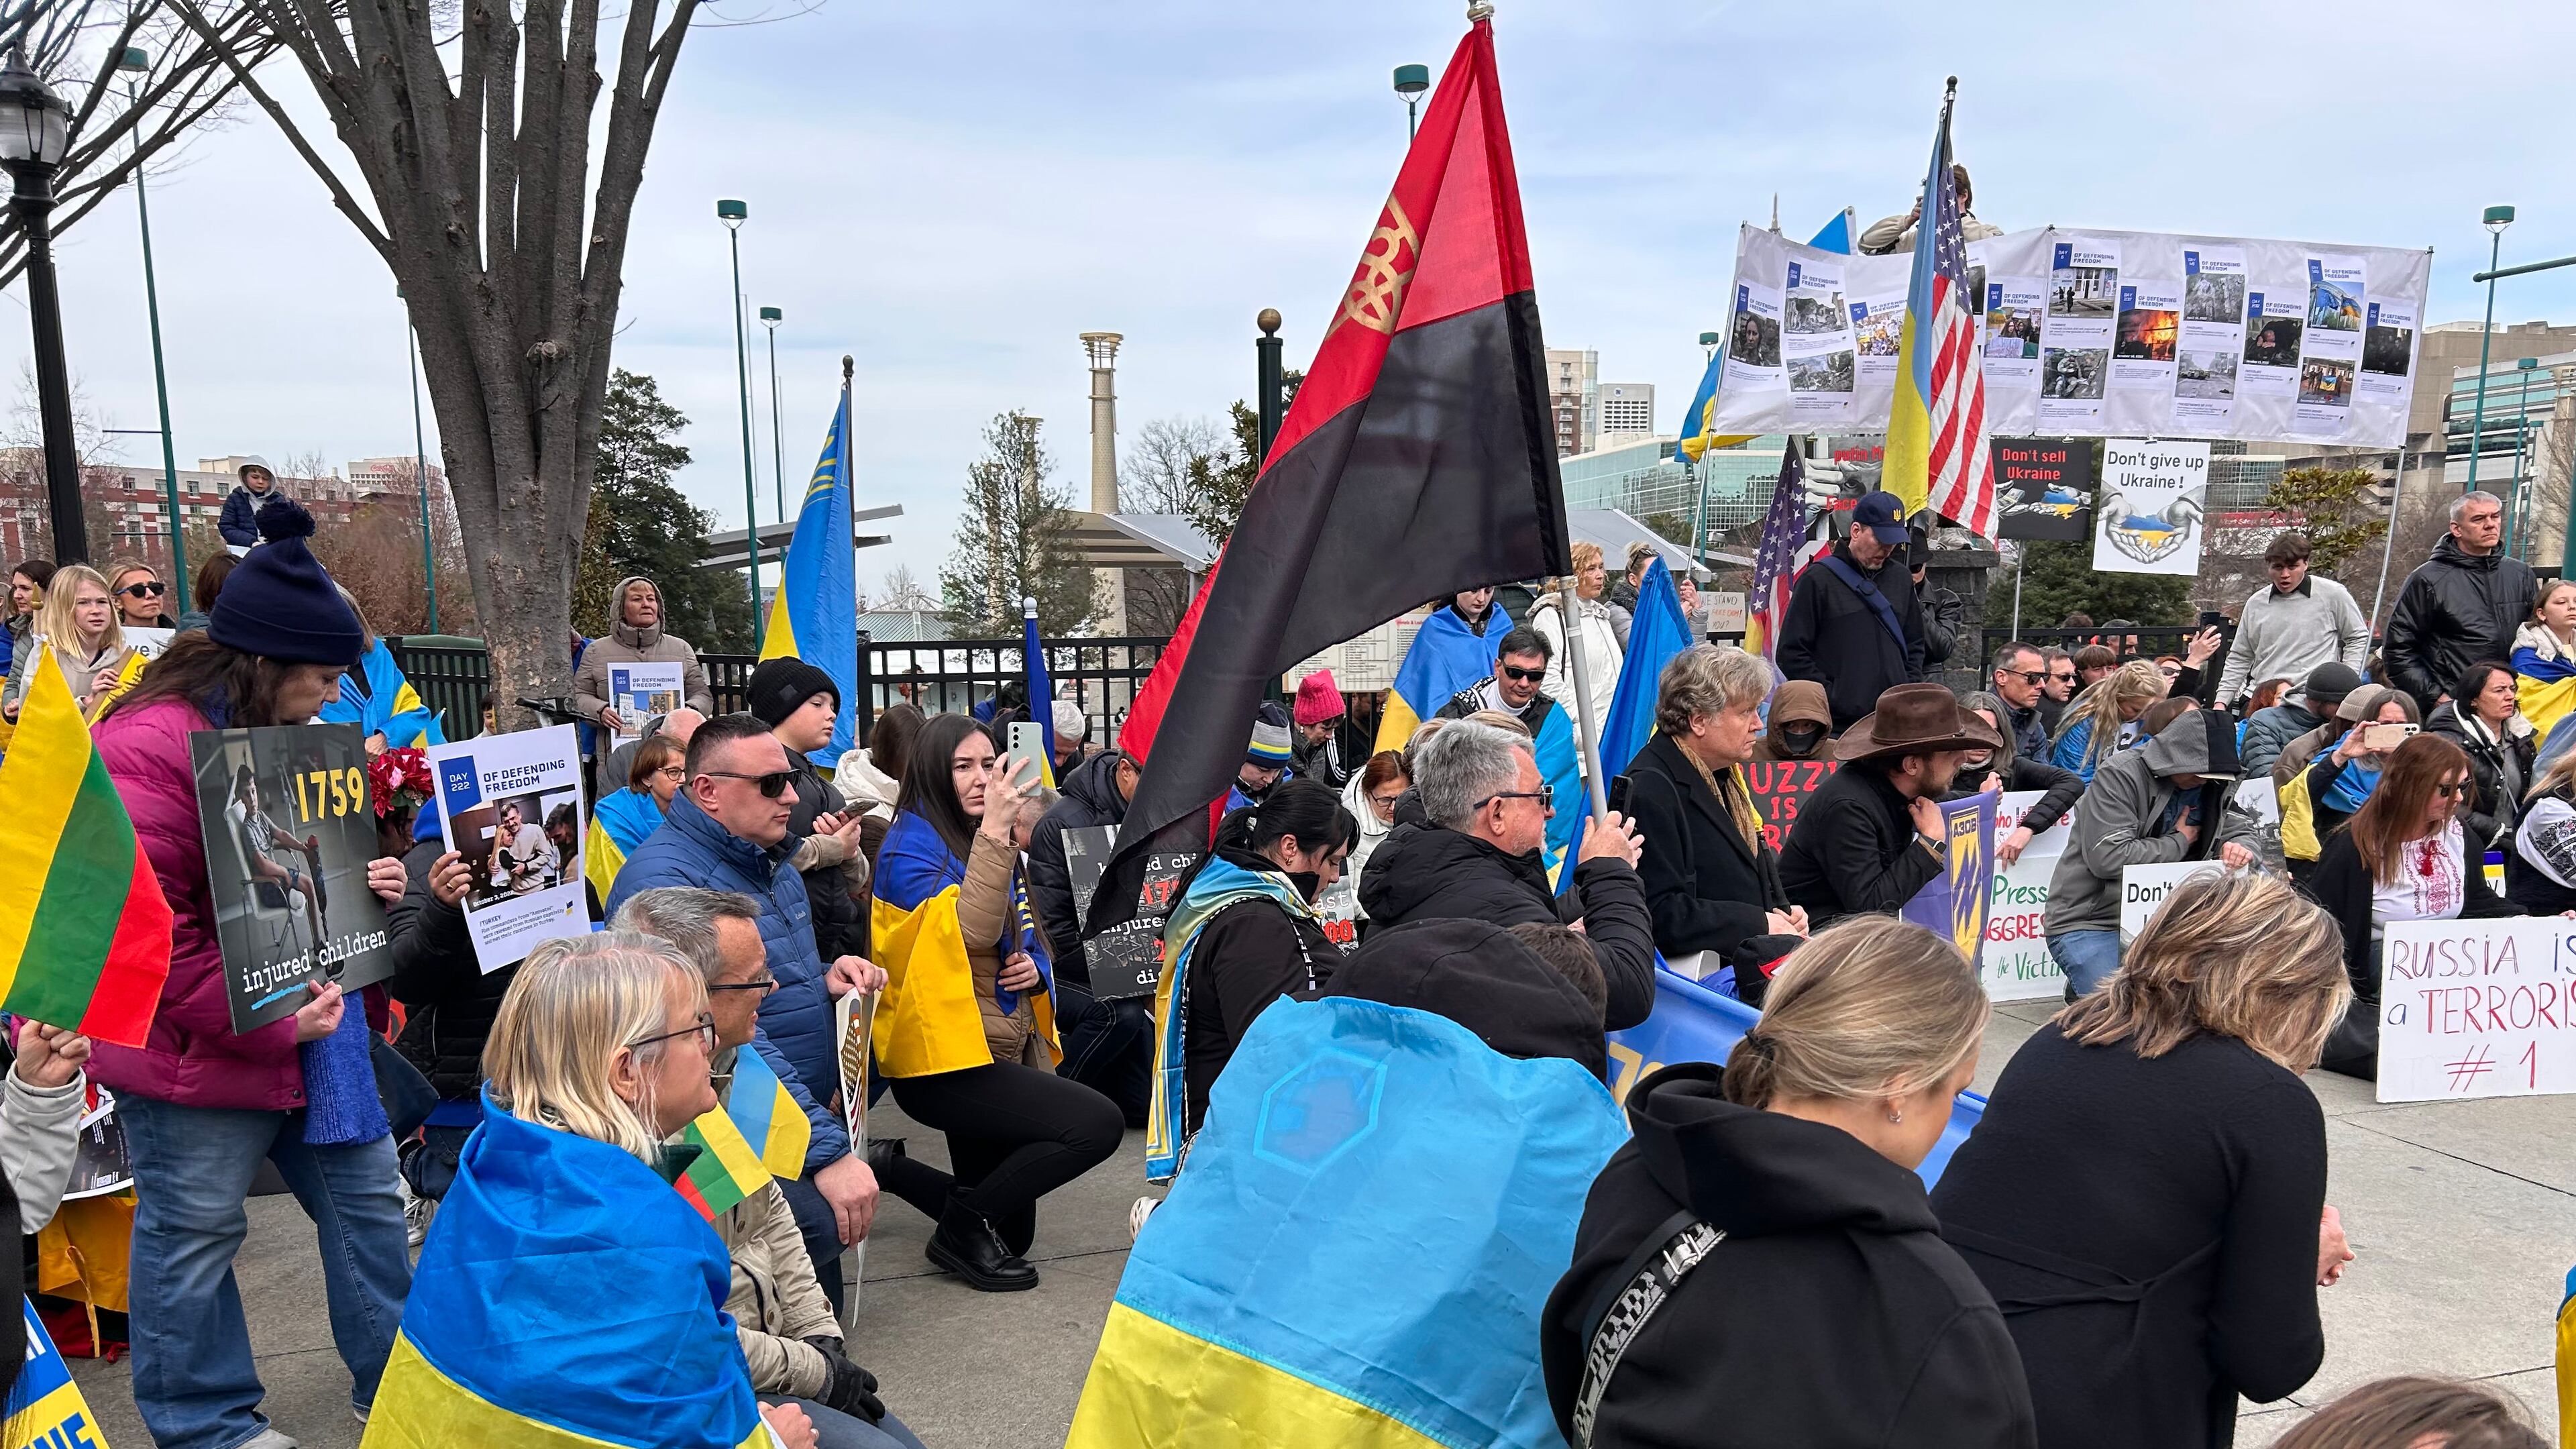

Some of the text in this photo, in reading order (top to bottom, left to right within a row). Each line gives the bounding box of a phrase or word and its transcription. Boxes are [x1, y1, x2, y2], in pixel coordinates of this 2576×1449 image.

[1809, 276, 1838, 285] DEFENDING
[1749, 304, 1768, 313] FREEDOM
[1756, 300, 1778, 311] DEFENDING
[1870, 304, 1900, 313] FREEDOM
[2002, 448, 2066, 463] Don't sell
[2108, 451, 2204, 472] Don't give up
[2007, 466, 2061, 480] Ukraine
[2121, 473, 2176, 488] Ukraine
[1714, 594, 1737, 606] STAND
[449, 772, 469, 784] DAY
[483, 759, 566, 783] OF DEFENDING
[451, 782, 470, 792] 222
[485, 775, 541, 793] FREEDOM
[296, 766, 364, 823] 1759
[1771, 796, 1798, 820] IS
[473, 896, 494, 907] October
[243, 930, 387, 994] injured children
[2387, 1003, 2407, 1026] a
[2444, 1040, 2536, 1092] # 1
